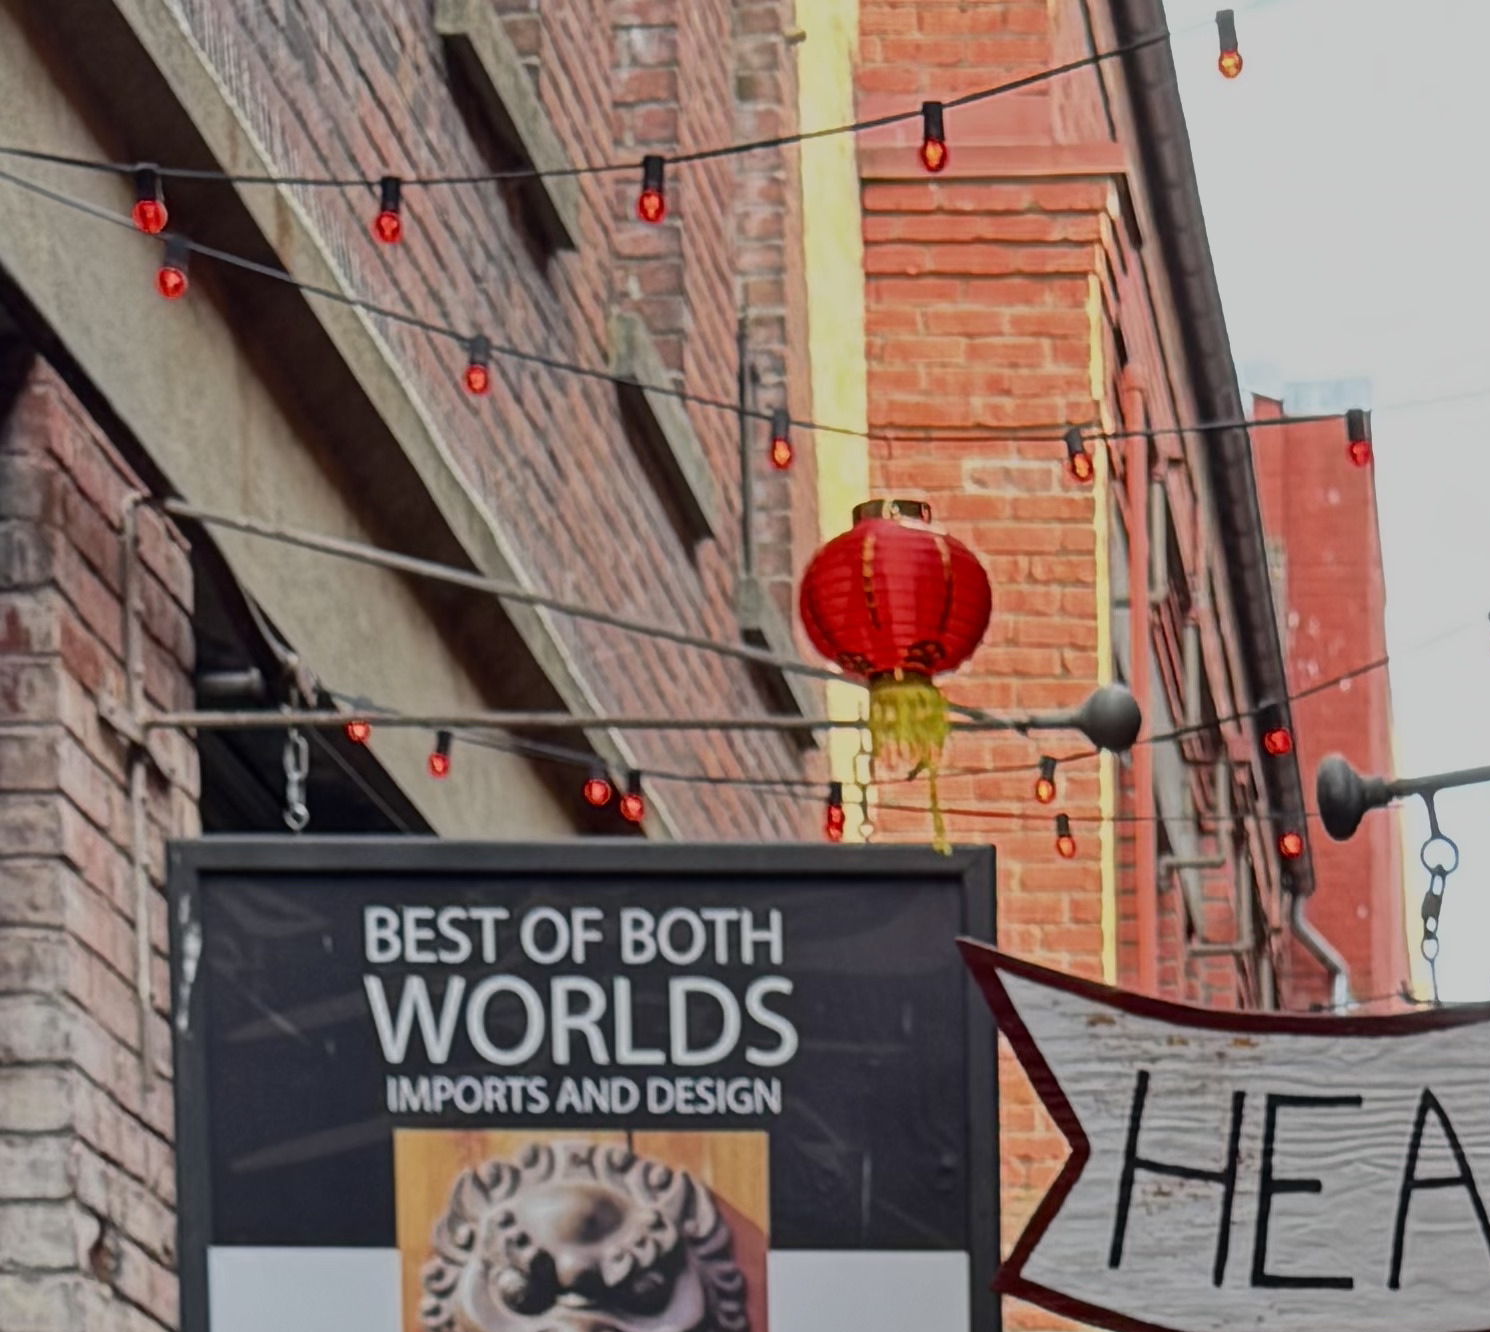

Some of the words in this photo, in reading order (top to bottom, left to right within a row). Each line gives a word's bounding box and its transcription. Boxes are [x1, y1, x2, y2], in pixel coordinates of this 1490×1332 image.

[364, 906, 510, 964] BEST
[520, 906, 604, 965] OF
[620, 907, 783, 965] BOTH
[363, 974, 799, 1067] WORLDS
[386, 1075, 550, 1114] IMPORTS
[556, 1077, 640, 1114] AND
[646, 1077, 782, 1115] DESIGN
